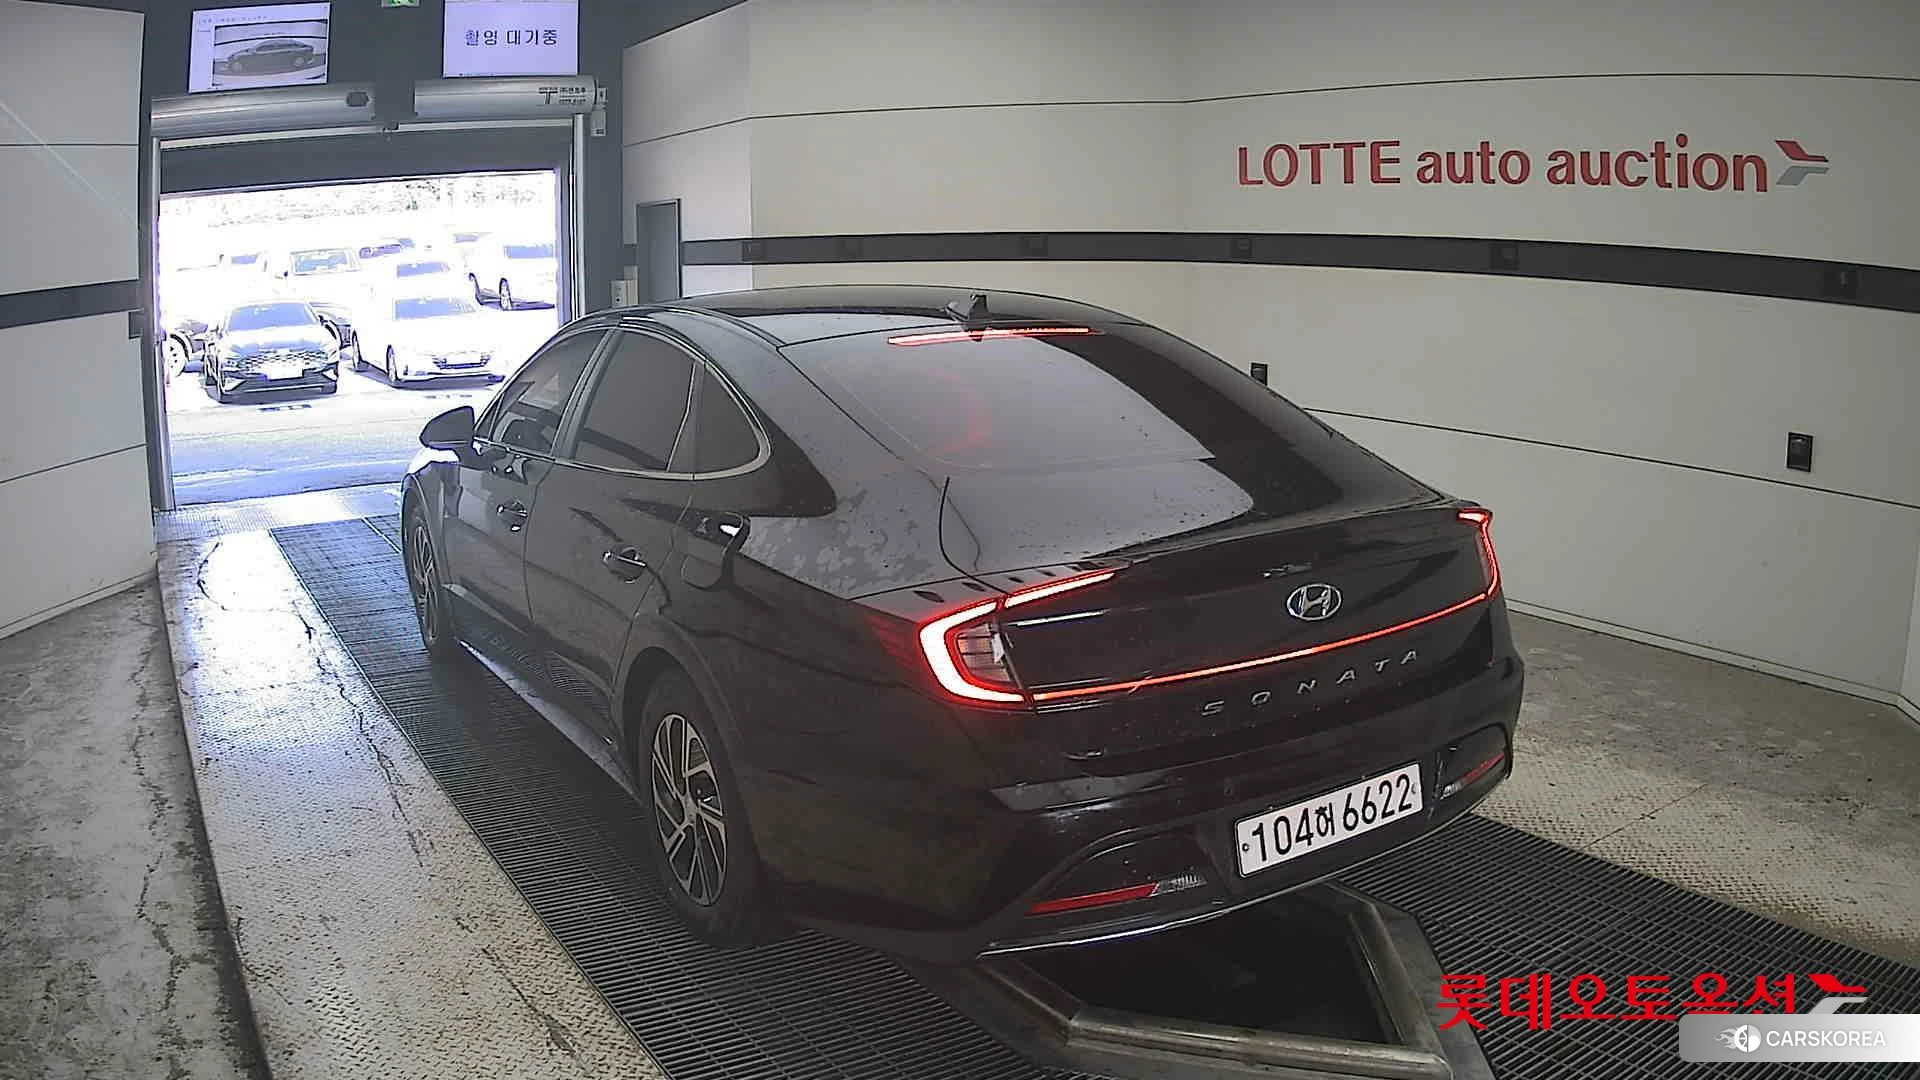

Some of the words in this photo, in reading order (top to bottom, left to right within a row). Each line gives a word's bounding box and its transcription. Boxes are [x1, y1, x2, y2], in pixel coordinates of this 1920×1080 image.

[506, 29, 557, 46] 대기중
[1238, 140, 1400, 188] LOTTE
[1417, 141, 1531, 185] auto
[1547, 134, 1768, 193] auction
[1201, 650, 1418, 716] SONATA
